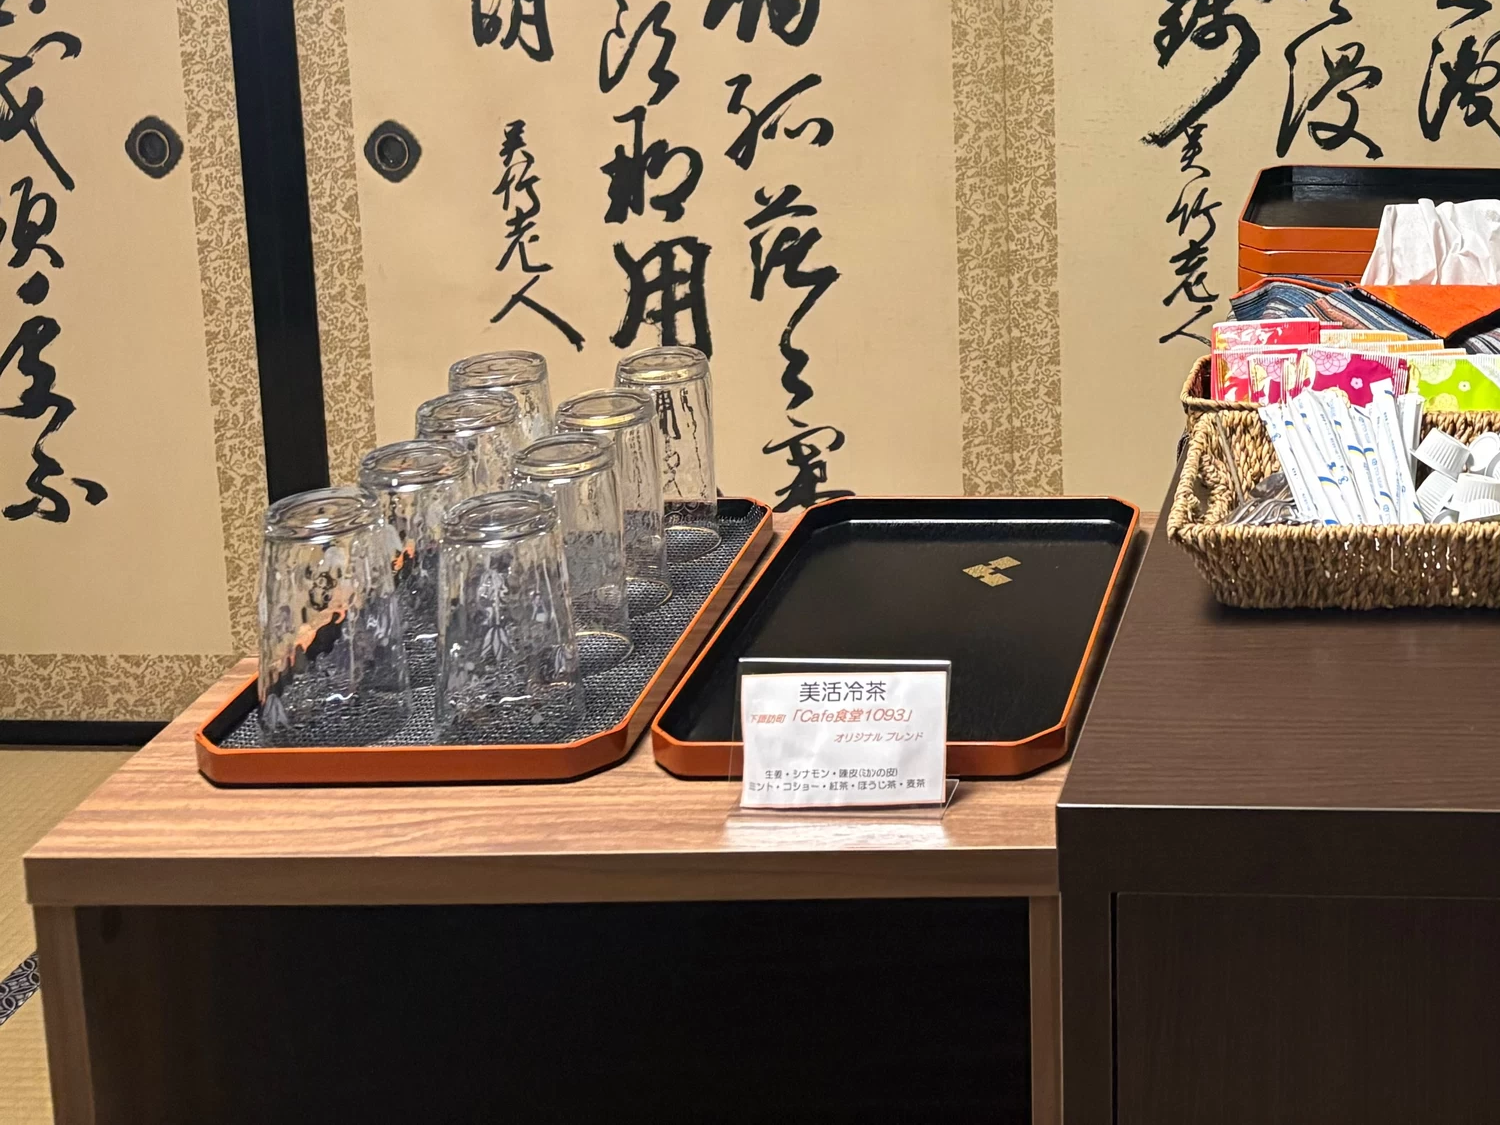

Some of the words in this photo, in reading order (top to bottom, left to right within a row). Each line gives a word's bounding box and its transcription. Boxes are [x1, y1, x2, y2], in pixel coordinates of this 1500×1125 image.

[799, 681, 887, 702] 美活冷茶
[791, 708, 913, 723] 「Cafe食堂1093」
[834, 732, 883, 743] オリジナル
[886, 731, 923, 741] ブレンド
